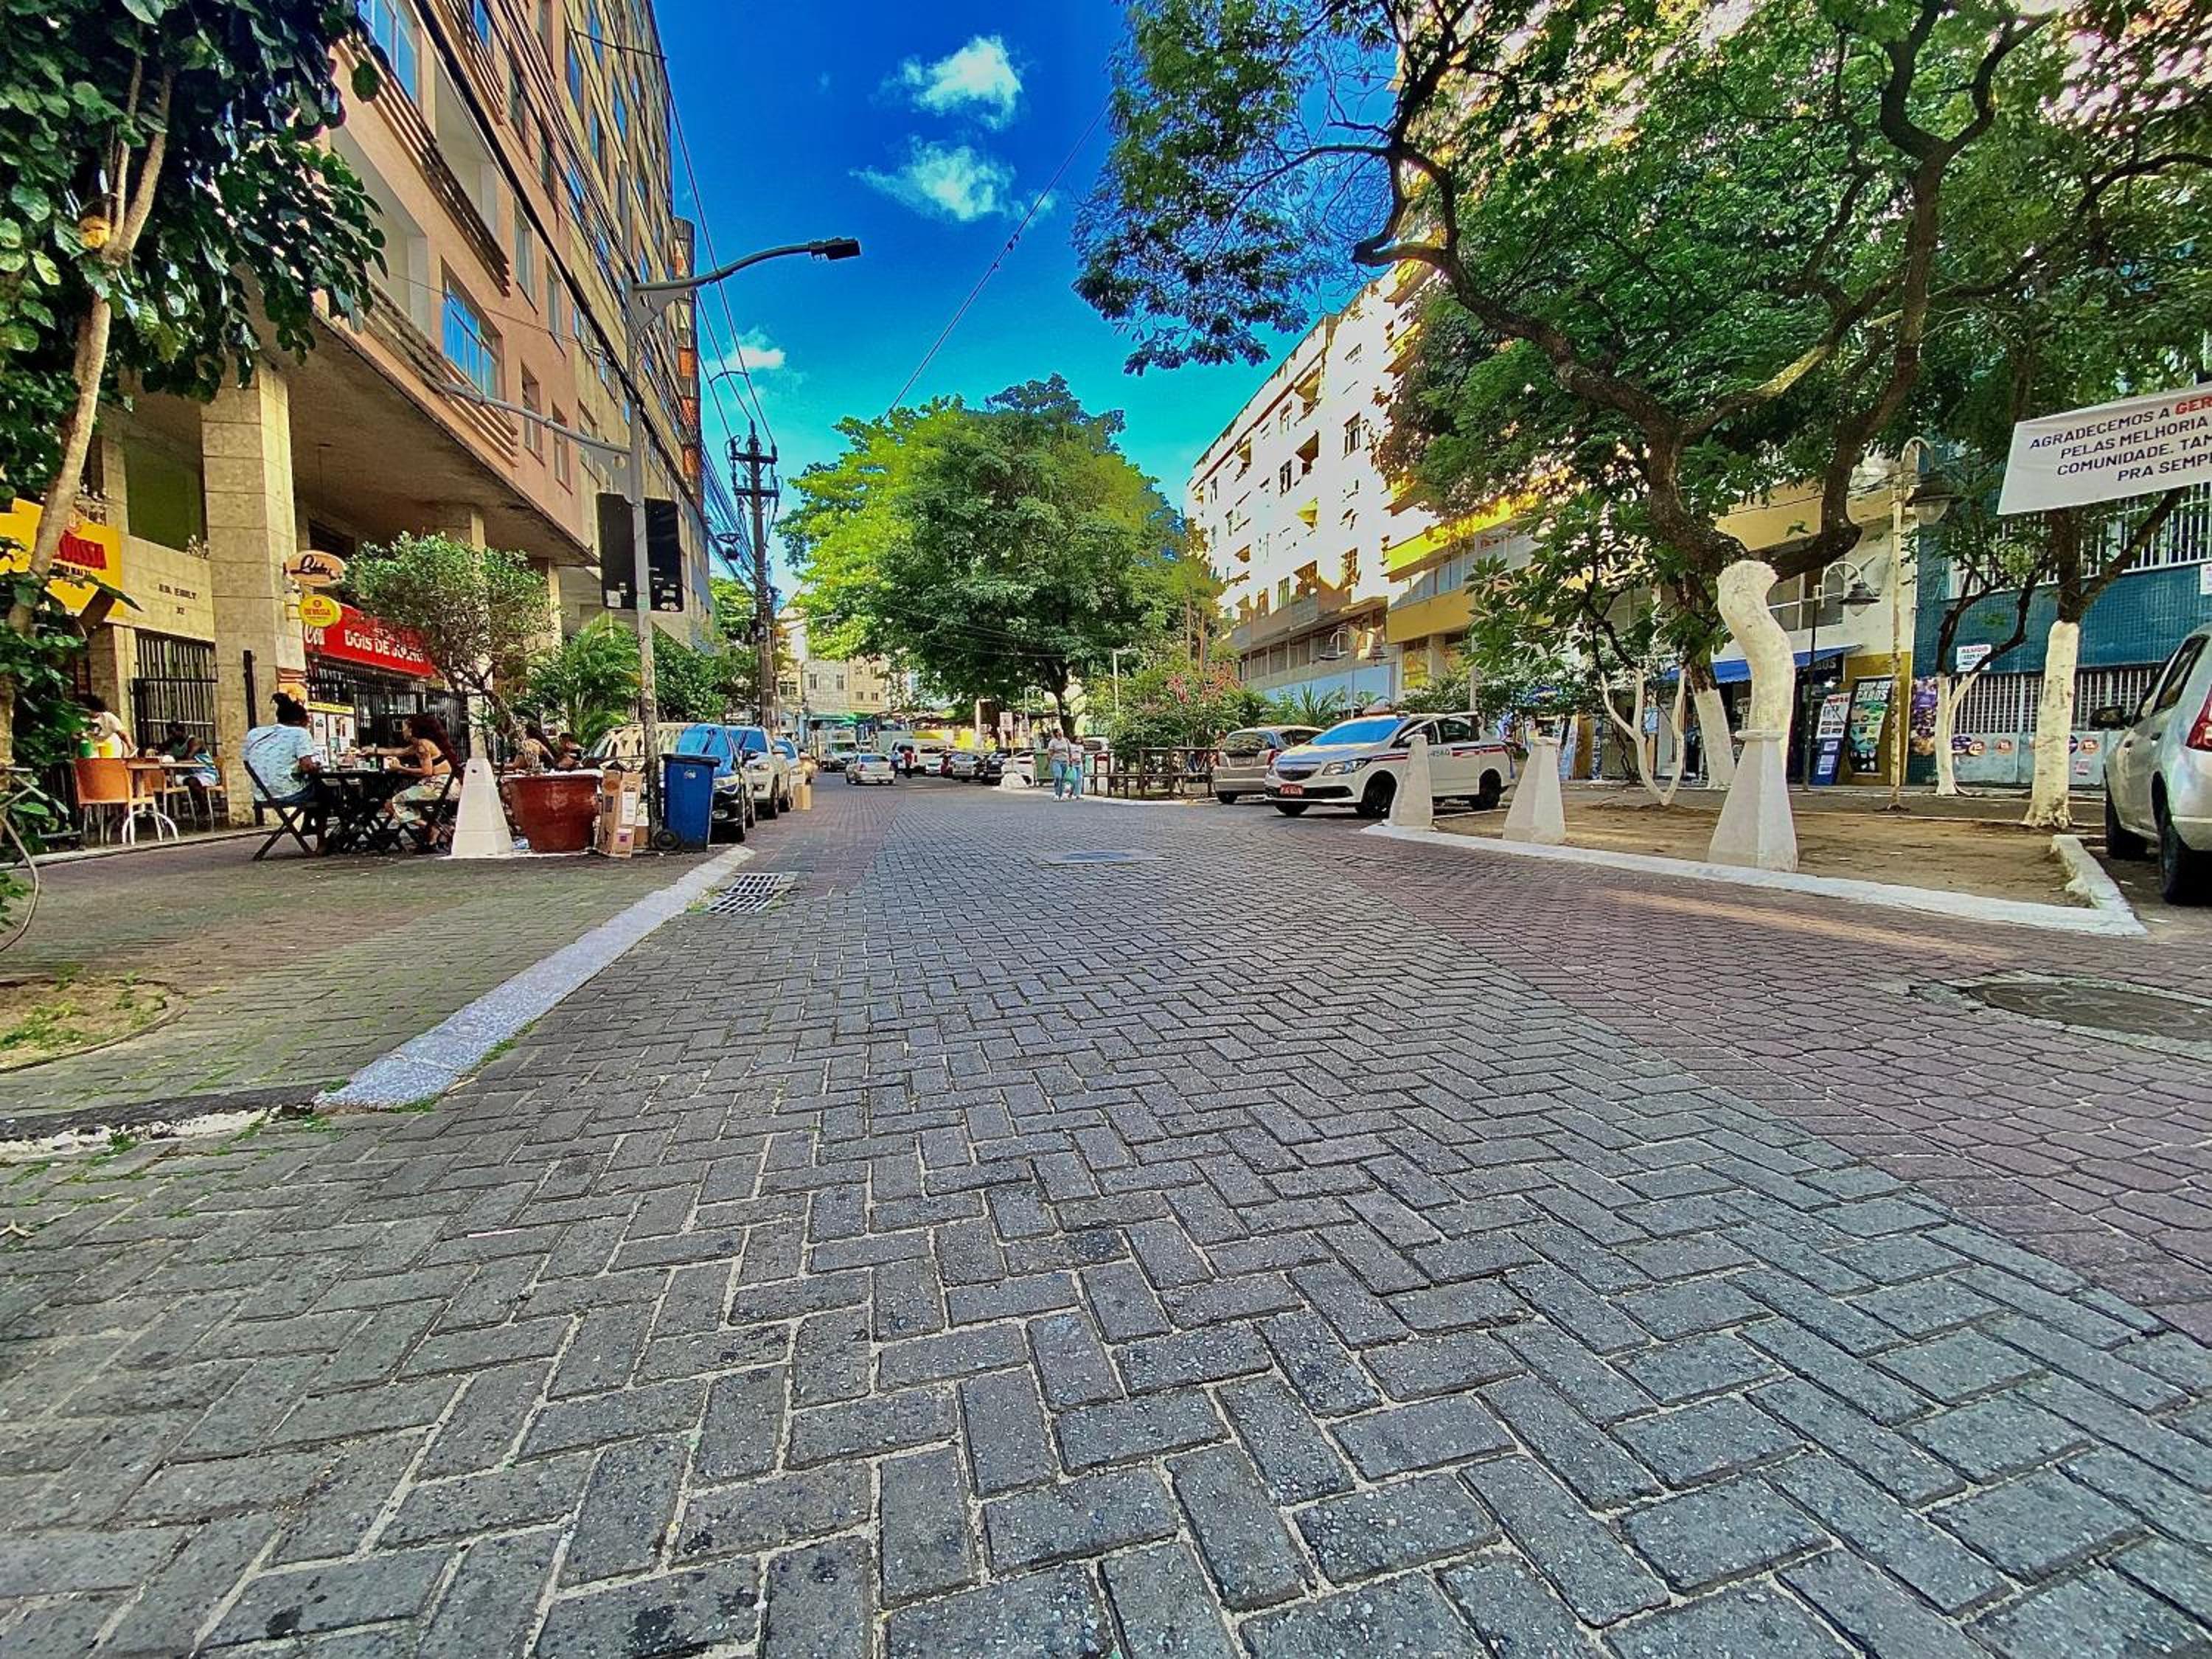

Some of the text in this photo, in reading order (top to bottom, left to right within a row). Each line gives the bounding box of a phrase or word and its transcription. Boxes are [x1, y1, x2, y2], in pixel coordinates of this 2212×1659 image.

[2029, 411, 2154, 449] AGRADECEMOS
[2159, 408, 2170, 419] A
[2061, 416, 2208, 459] PELAS MELHORIA
[2056, 443, 2174, 476] COMUNIDADE.
[2118, 452, 2212, 481] PRA SEMP
[344, 629, 372, 652] DOIS
[375, 638, 390, 655] DE
